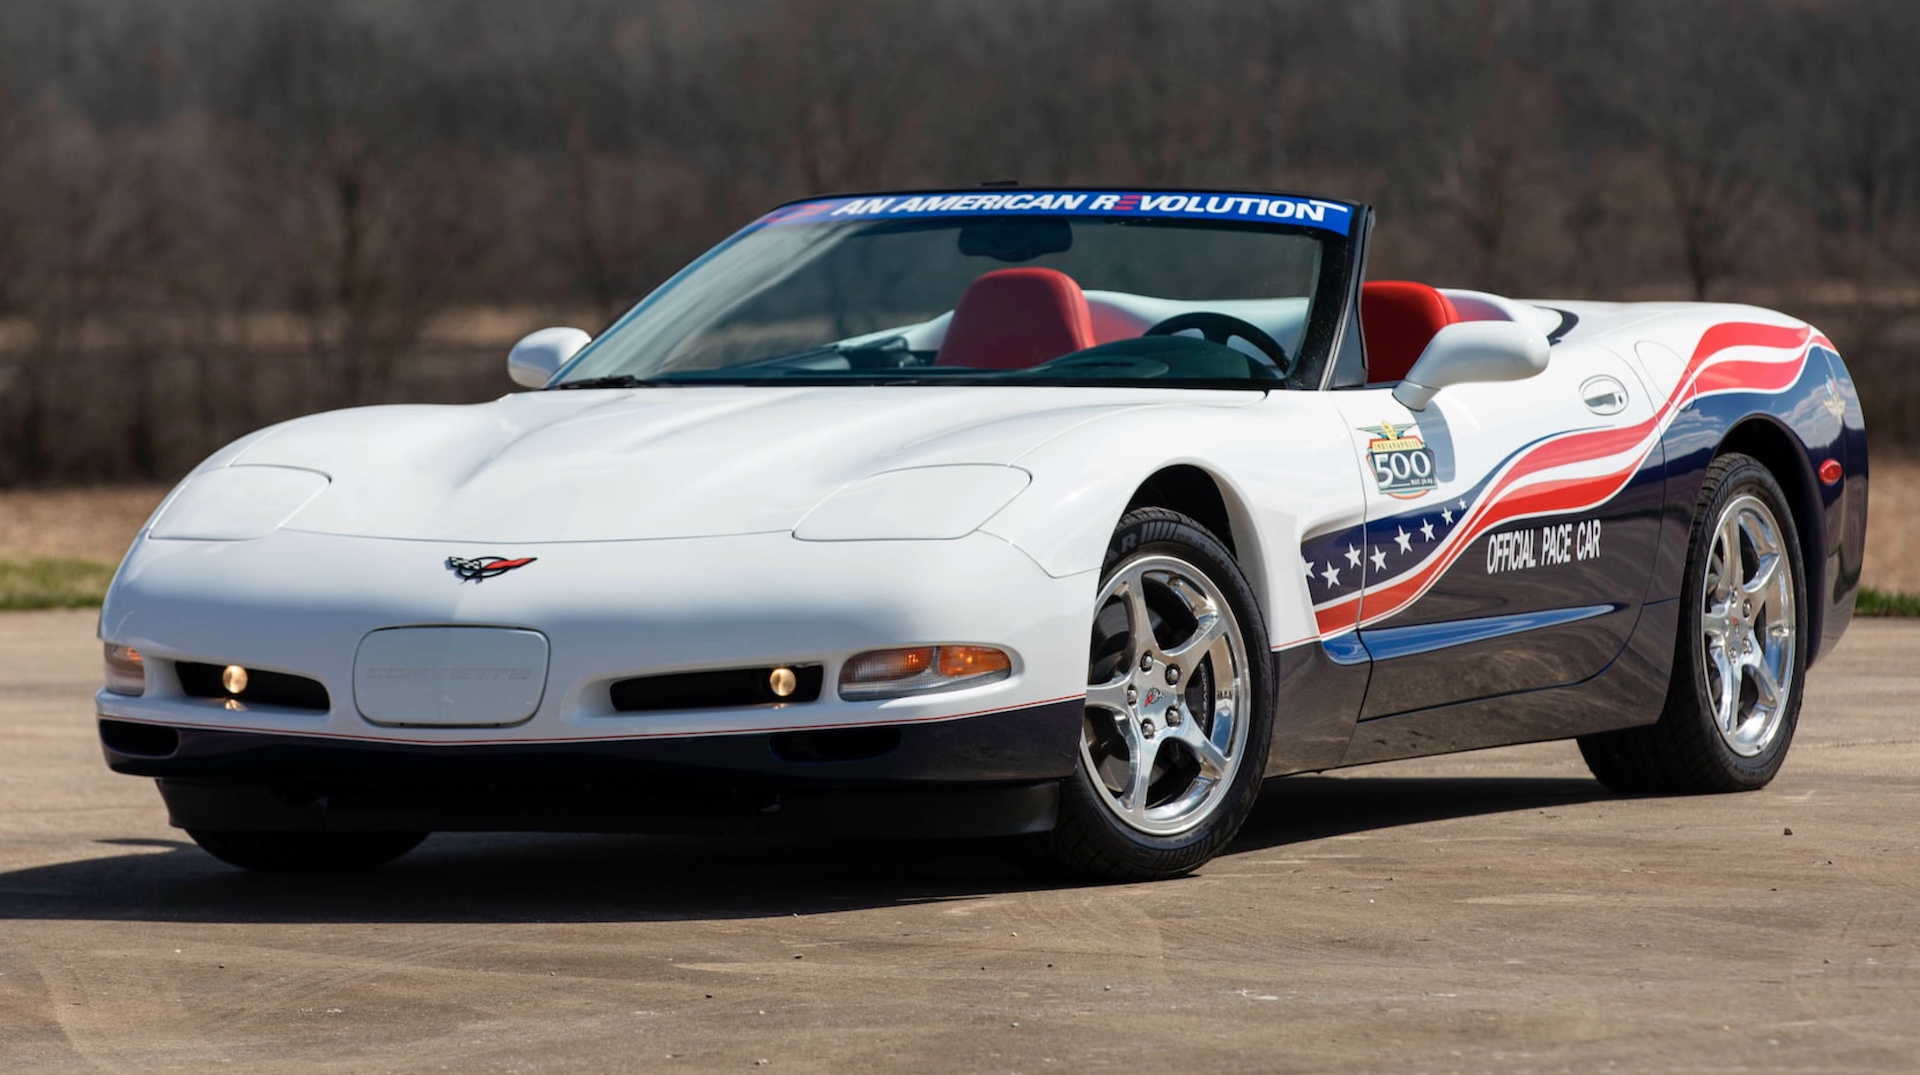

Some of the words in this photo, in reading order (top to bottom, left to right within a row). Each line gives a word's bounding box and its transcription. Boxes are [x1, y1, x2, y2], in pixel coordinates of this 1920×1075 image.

[831, 198, 897, 216] AN
[889, 194, 1087, 214] AMERICAN
[1088, 194, 1327, 222] REVOLUTION
[1374, 440, 1420, 451] INDIANAPOLIS
[1374, 450, 1432, 489] 500
[1486, 528, 1537, 575] OFFICIAL
[1541, 523, 1573, 566] PACE
[1576, 518, 1602, 561] CAR
[366, 666, 534, 681] CORVETTE
